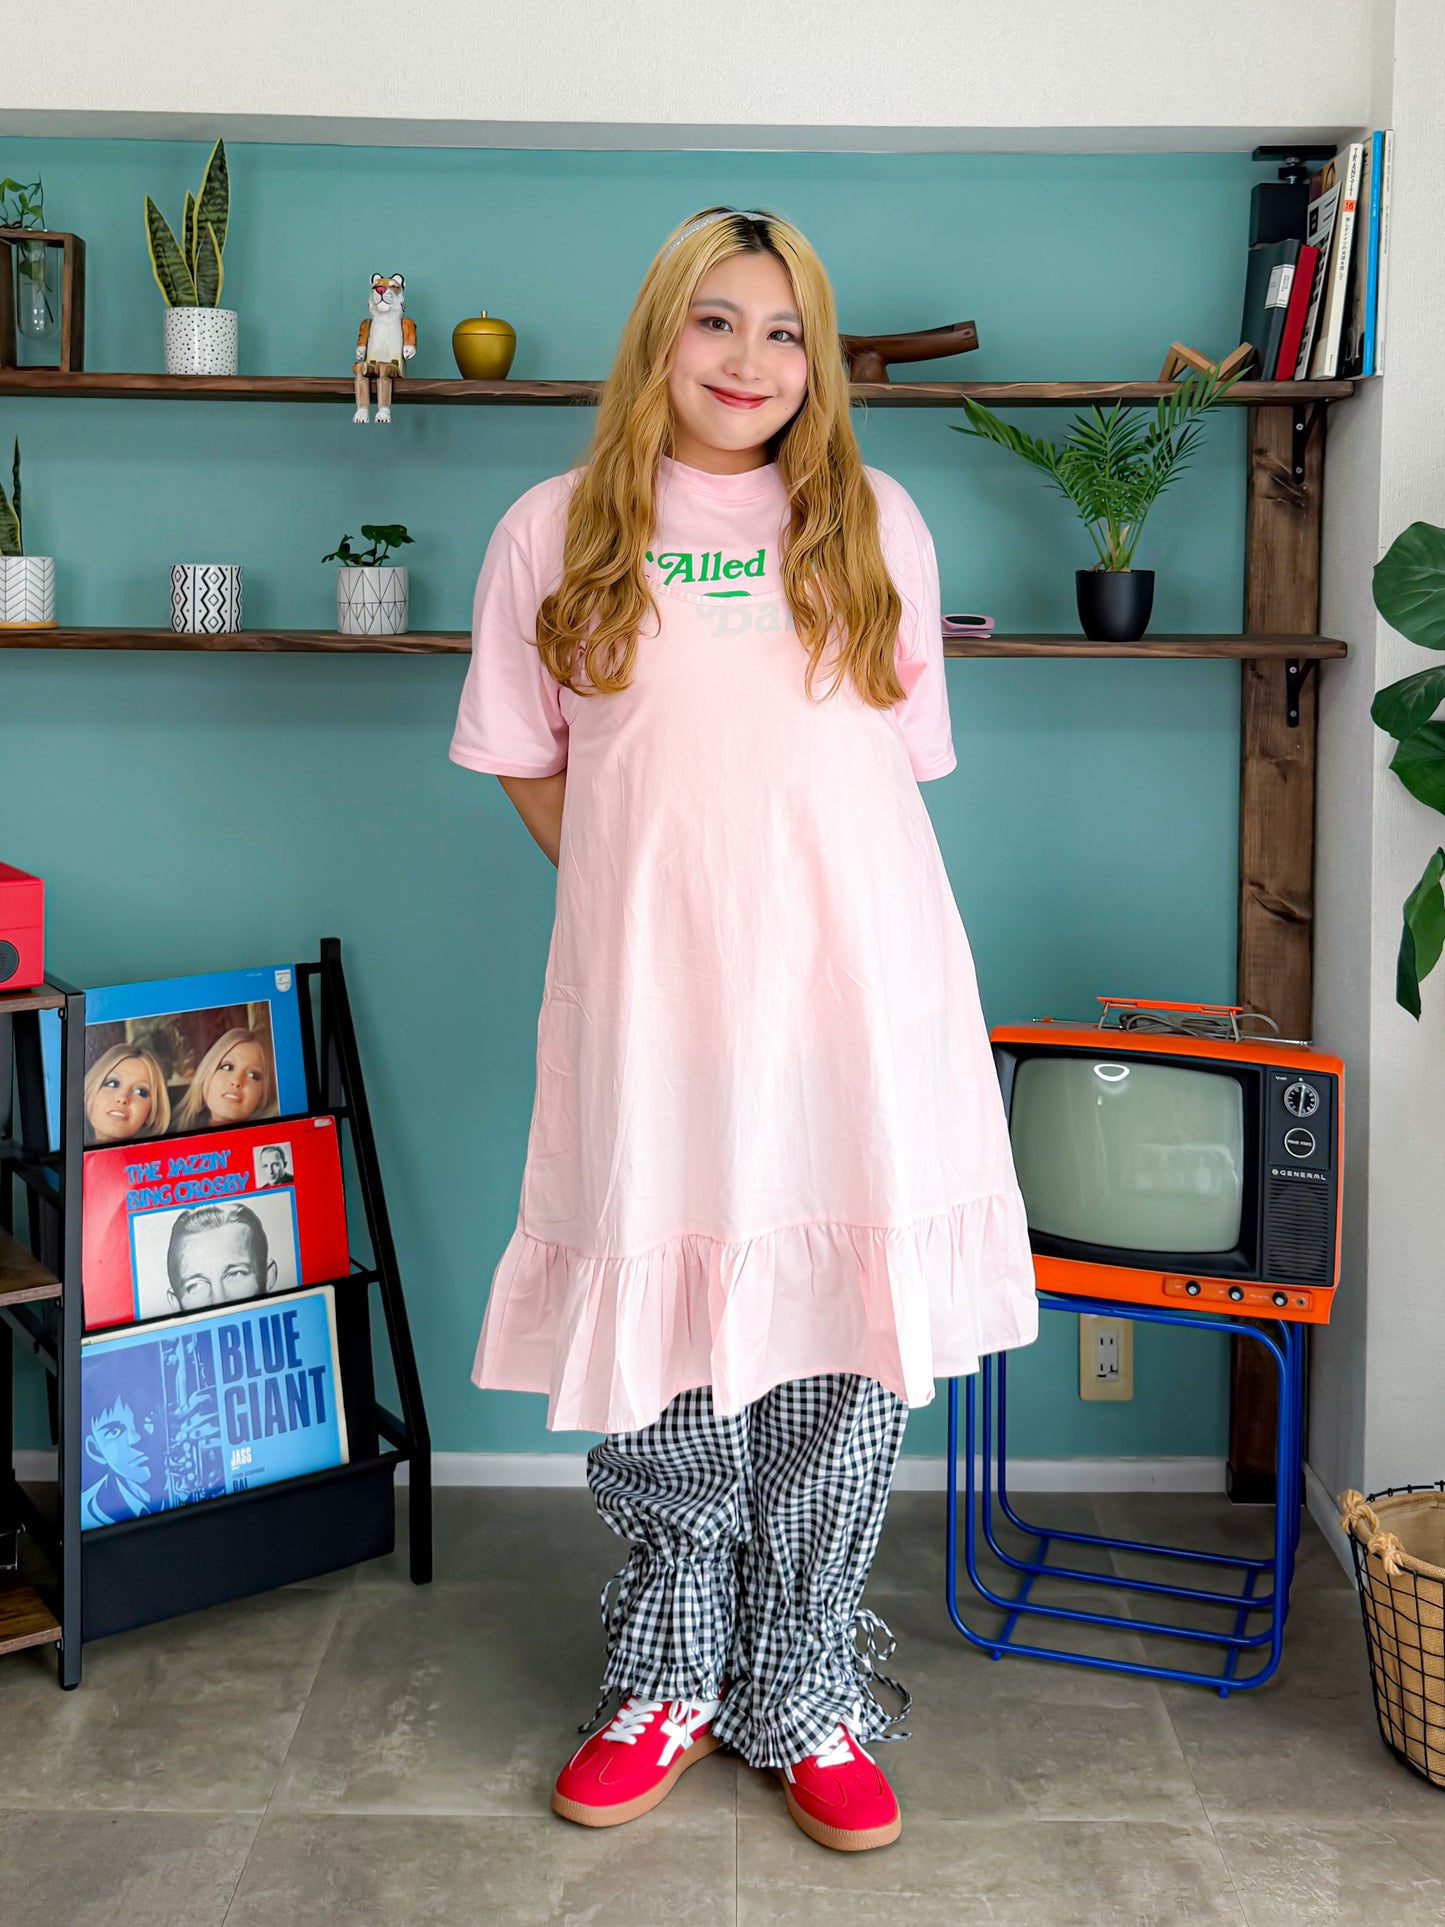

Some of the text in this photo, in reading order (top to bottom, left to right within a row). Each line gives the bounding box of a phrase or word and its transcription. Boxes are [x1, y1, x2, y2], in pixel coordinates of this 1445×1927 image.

[125, 1161, 162, 1184] THE
[1279, 1169, 1326, 1181] GENERAL
[126, 1172, 249, 1210] BING CROSBY
[217, 1309, 303, 1385] BLUE
[224, 1365, 327, 1446] GIANT
[231, 1446, 252, 1467] JASS
